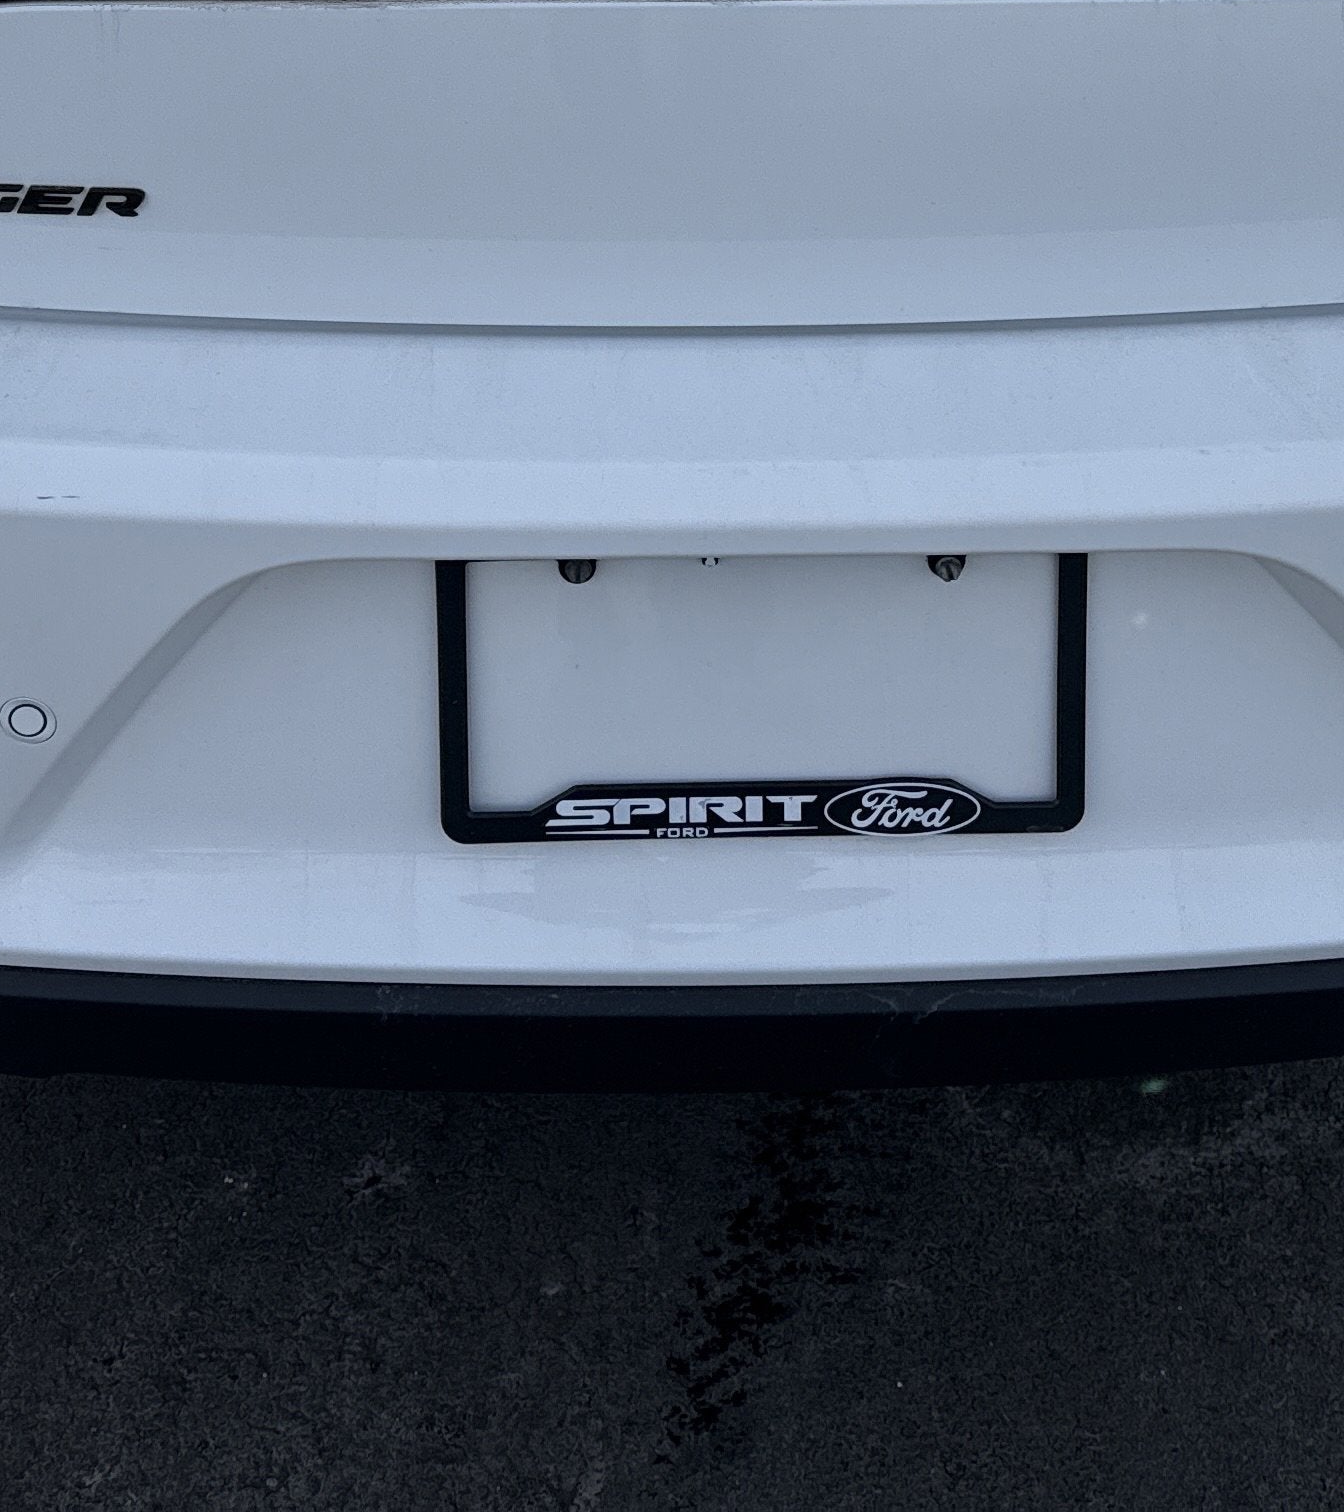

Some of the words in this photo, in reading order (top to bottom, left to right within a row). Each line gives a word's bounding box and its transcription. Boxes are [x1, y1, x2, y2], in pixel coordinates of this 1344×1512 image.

[545, 795, 818, 827] SPIRIT
[851, 789, 954, 828] Ford
[656, 827, 709, 838] FORD
